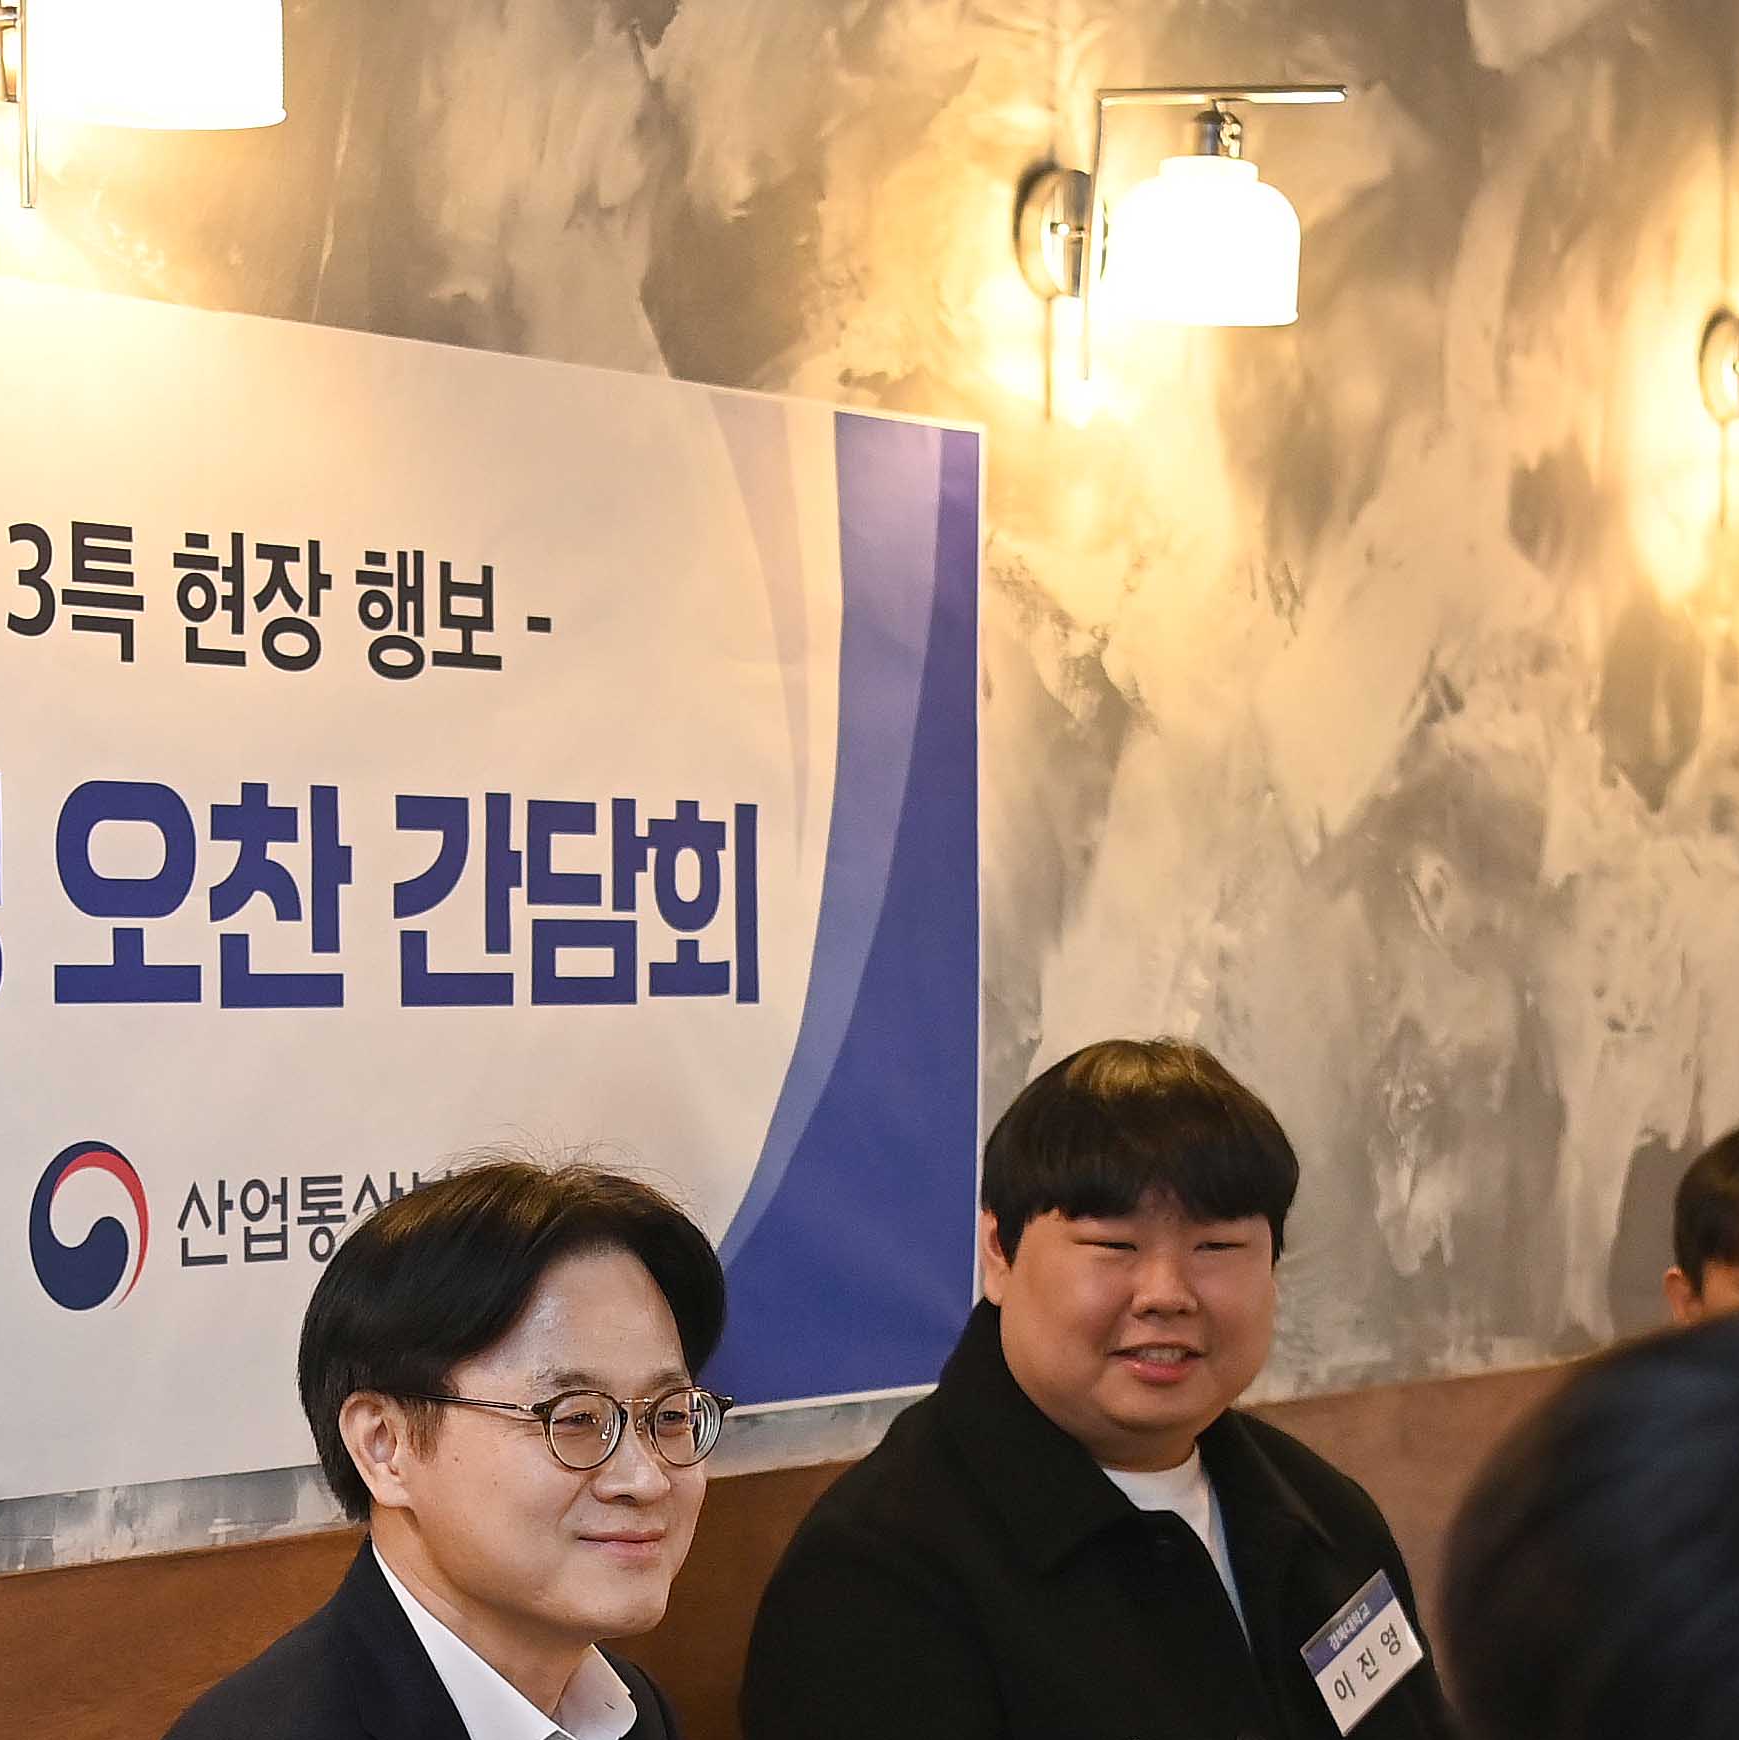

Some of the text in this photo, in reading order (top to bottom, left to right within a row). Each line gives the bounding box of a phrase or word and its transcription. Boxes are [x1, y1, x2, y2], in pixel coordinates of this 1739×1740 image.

[8, 521, 143, 662] 3특
[174, 533, 332, 671] 현장
[356, 550, 501, 679] 행보
[54, 781, 351, 1008] 오찬
[394, 793, 759, 1007] 간담회
[177, 1170, 455, 1266] 산업통
